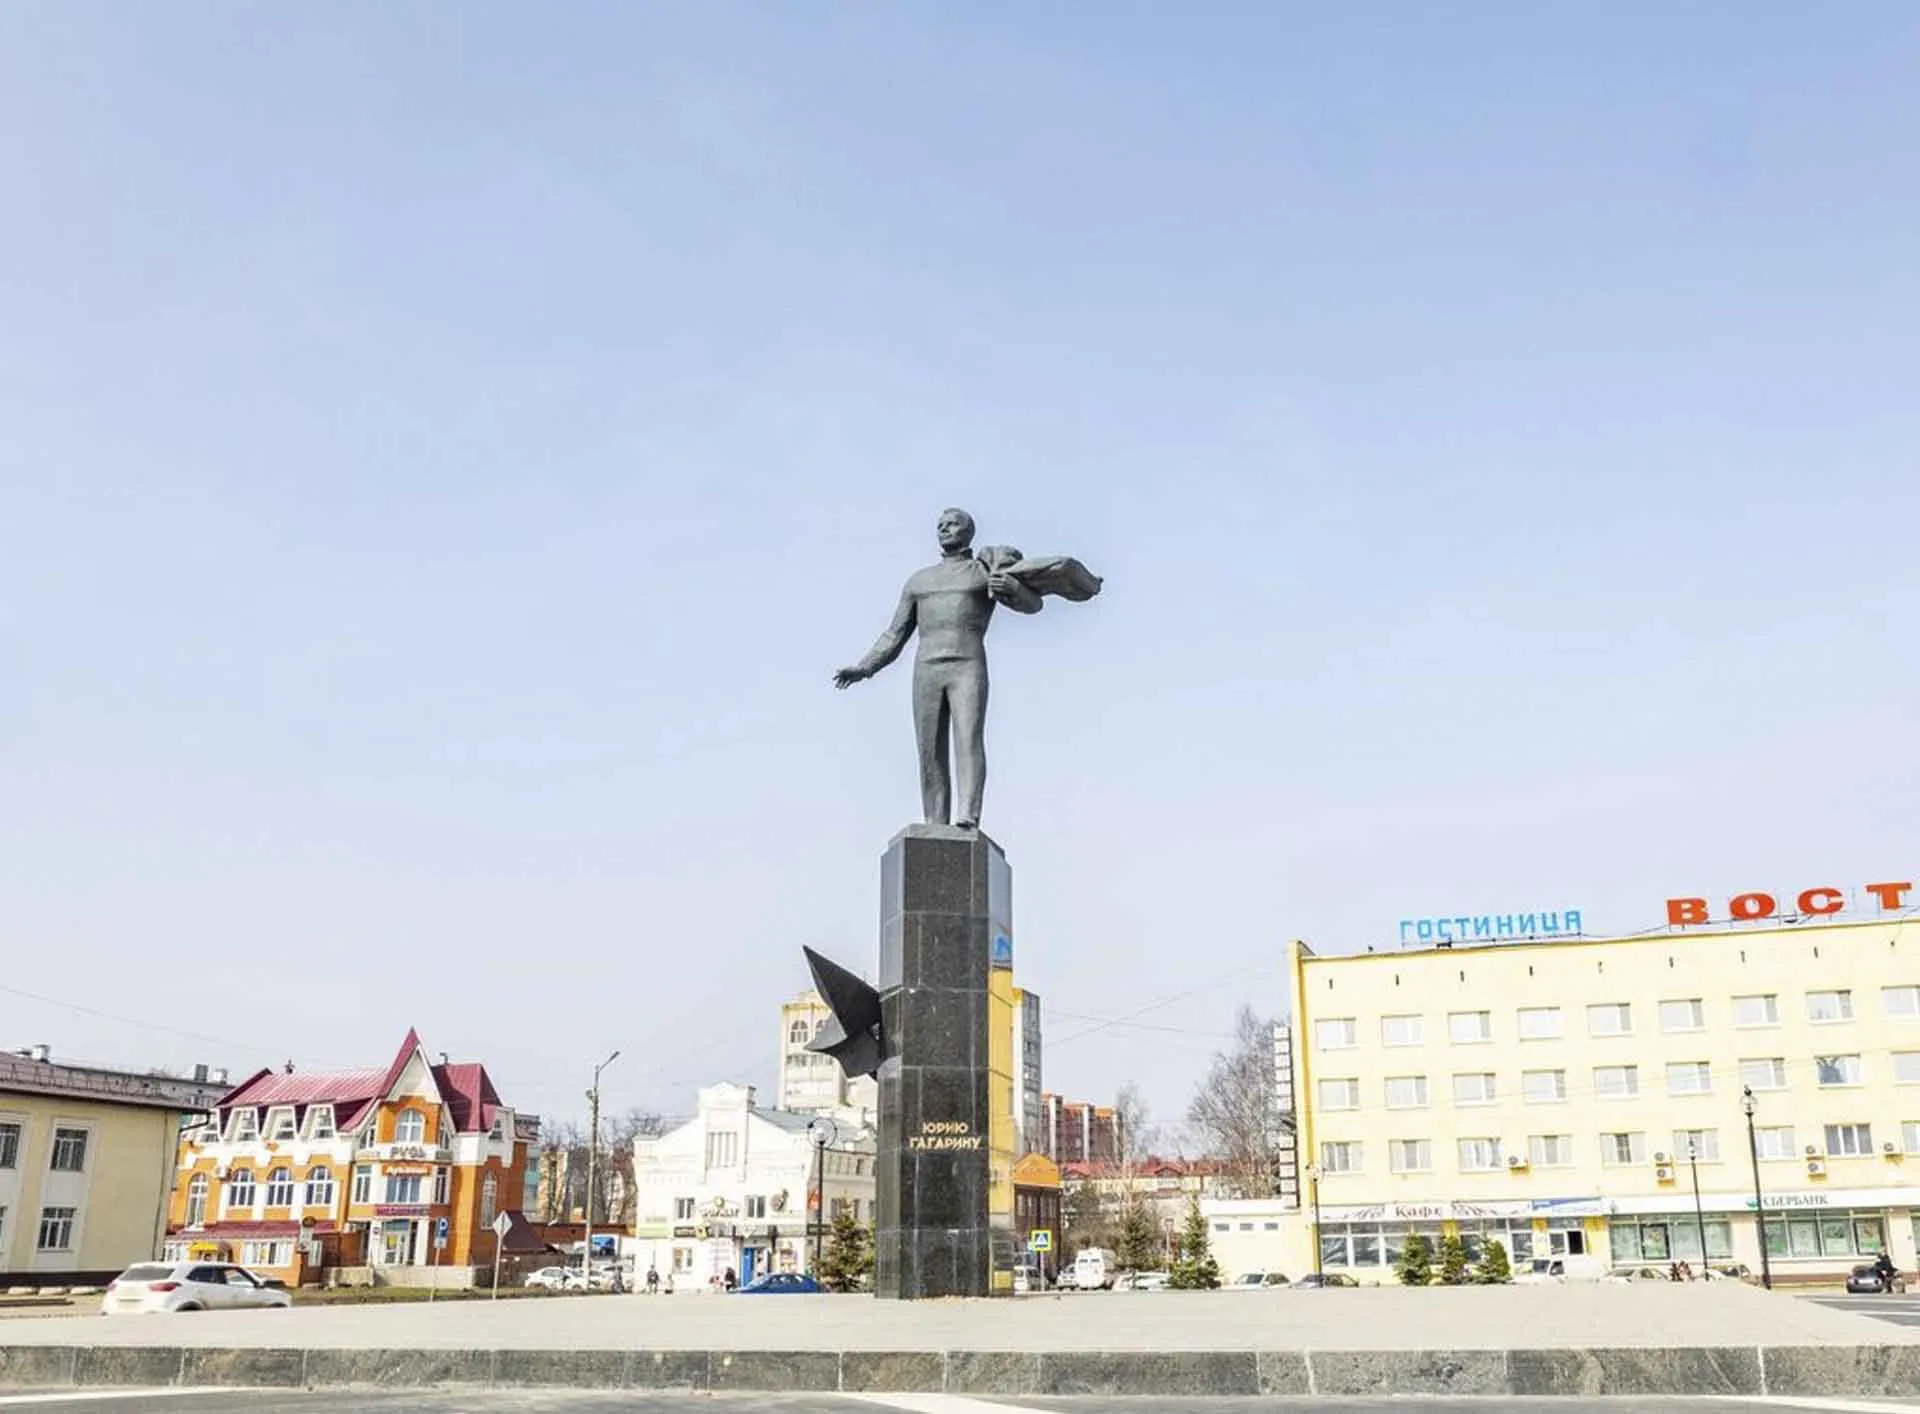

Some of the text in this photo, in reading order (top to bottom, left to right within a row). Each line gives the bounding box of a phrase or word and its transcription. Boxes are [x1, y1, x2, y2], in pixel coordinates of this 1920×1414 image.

[1400, 882, 1912, 940] ГОСТИНИЦА ВОСТ
[922, 1121, 969, 1135] ЮРИЮ
[909, 1136, 983, 1150] ГАГАРИНУ
[1763, 1194, 1829, 1207] СБЕРБАНК
